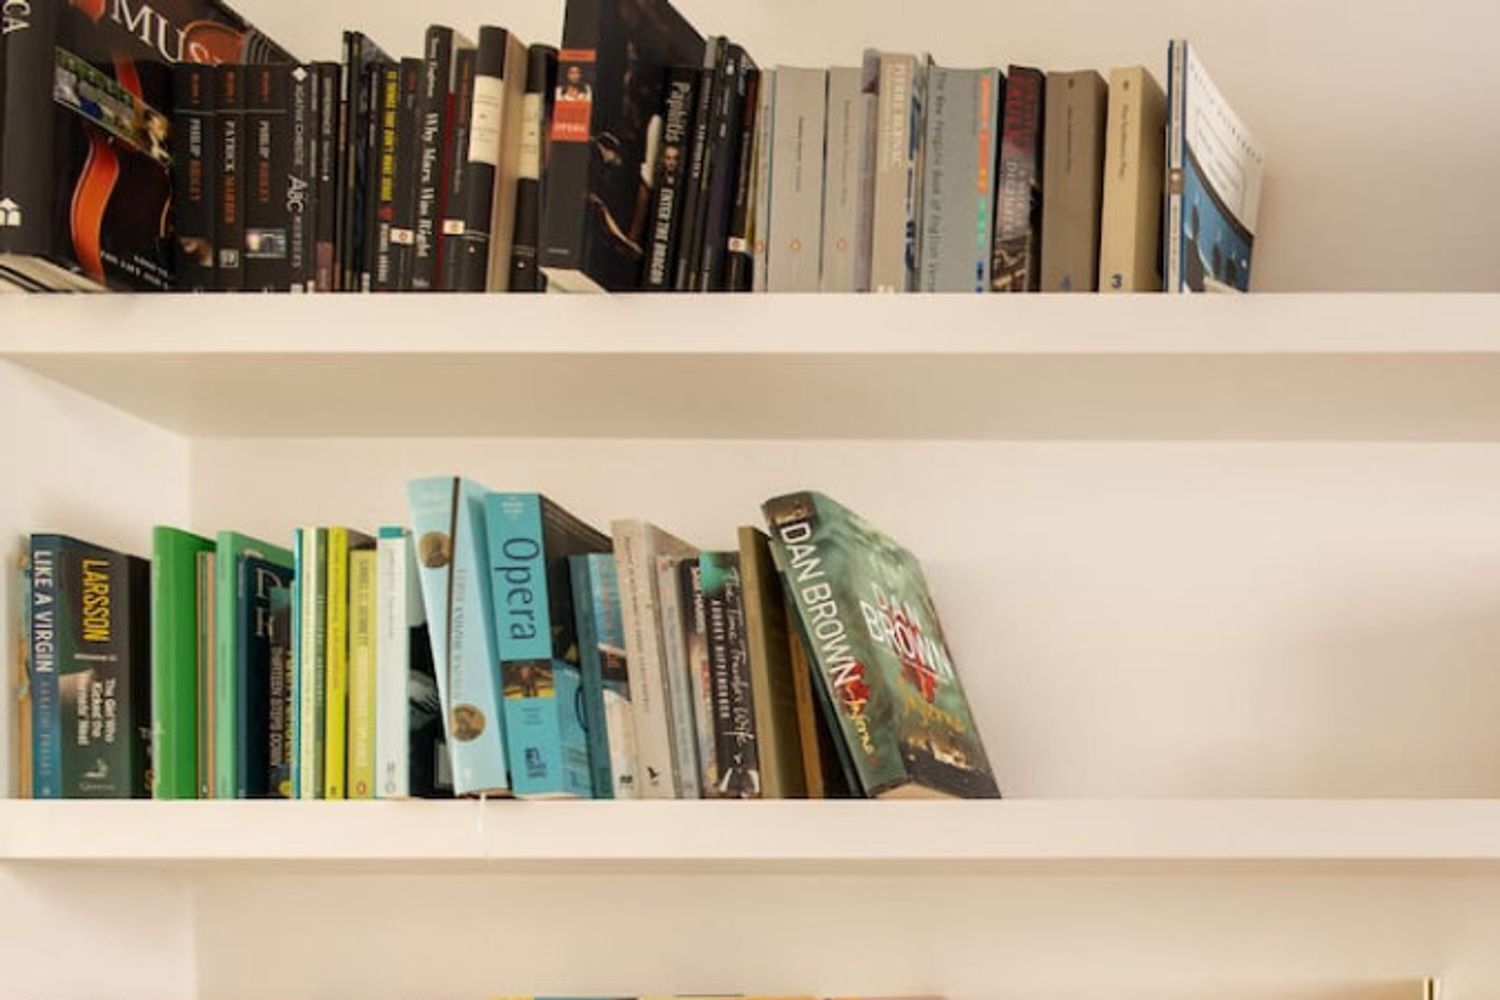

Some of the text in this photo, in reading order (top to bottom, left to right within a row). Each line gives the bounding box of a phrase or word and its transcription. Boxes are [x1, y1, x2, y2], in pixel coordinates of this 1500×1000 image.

[416, 112, 439, 257] Why Marx Was Right
[34, 550, 54, 672] LIKE A VIRGIN
[82, 559, 110, 642] LARSSON
[493, 537, 540, 640] Opera
[780, 521, 861, 688] DAN BROWN
